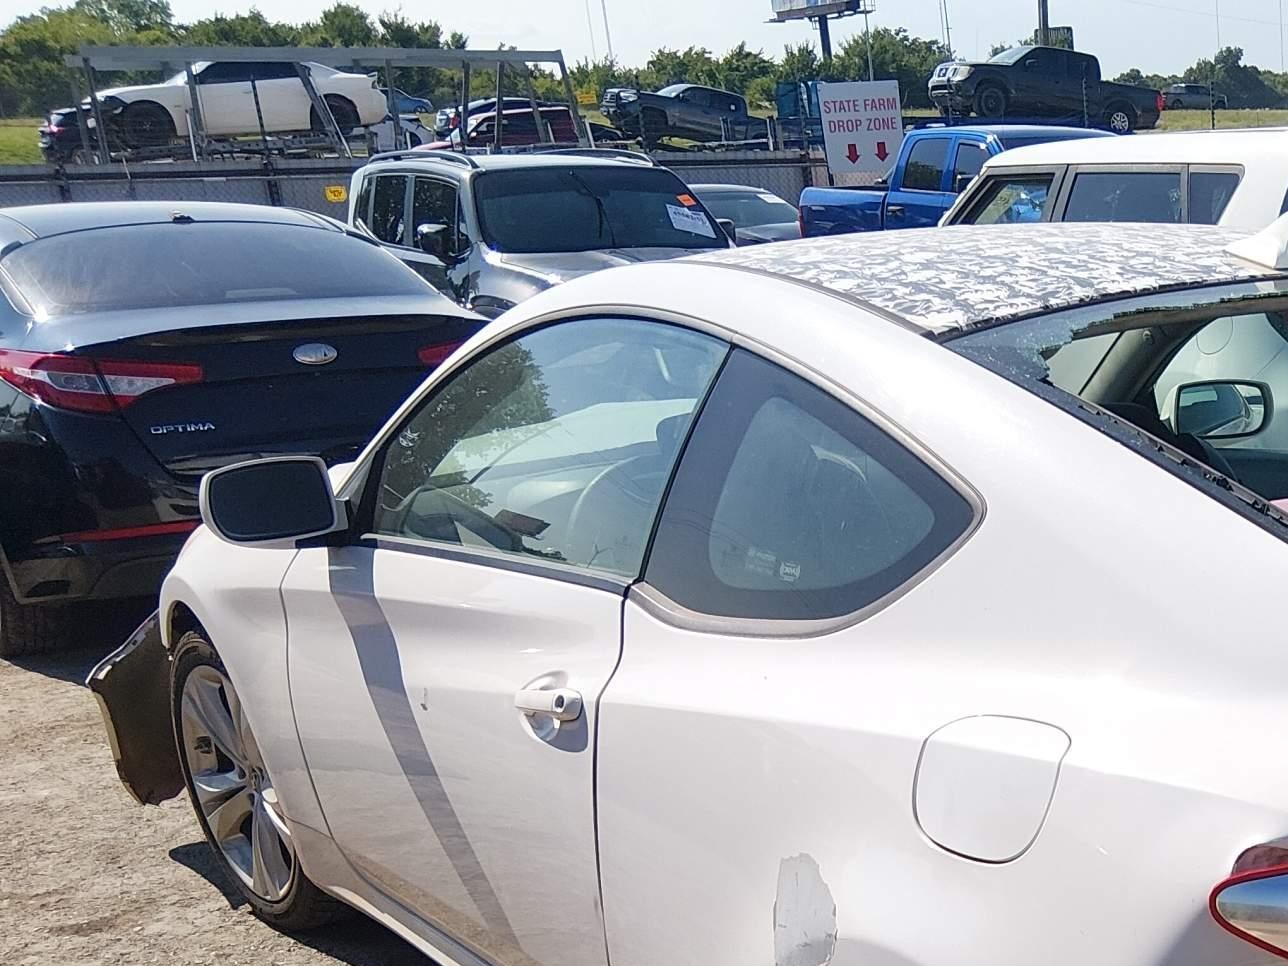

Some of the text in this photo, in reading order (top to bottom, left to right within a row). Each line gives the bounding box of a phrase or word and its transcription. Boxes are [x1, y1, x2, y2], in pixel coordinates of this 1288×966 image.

[824, 98, 897, 113] STATE FARM
[829, 117, 897, 133] DROP ZONE
[151, 422, 216, 434] OPTIMA
